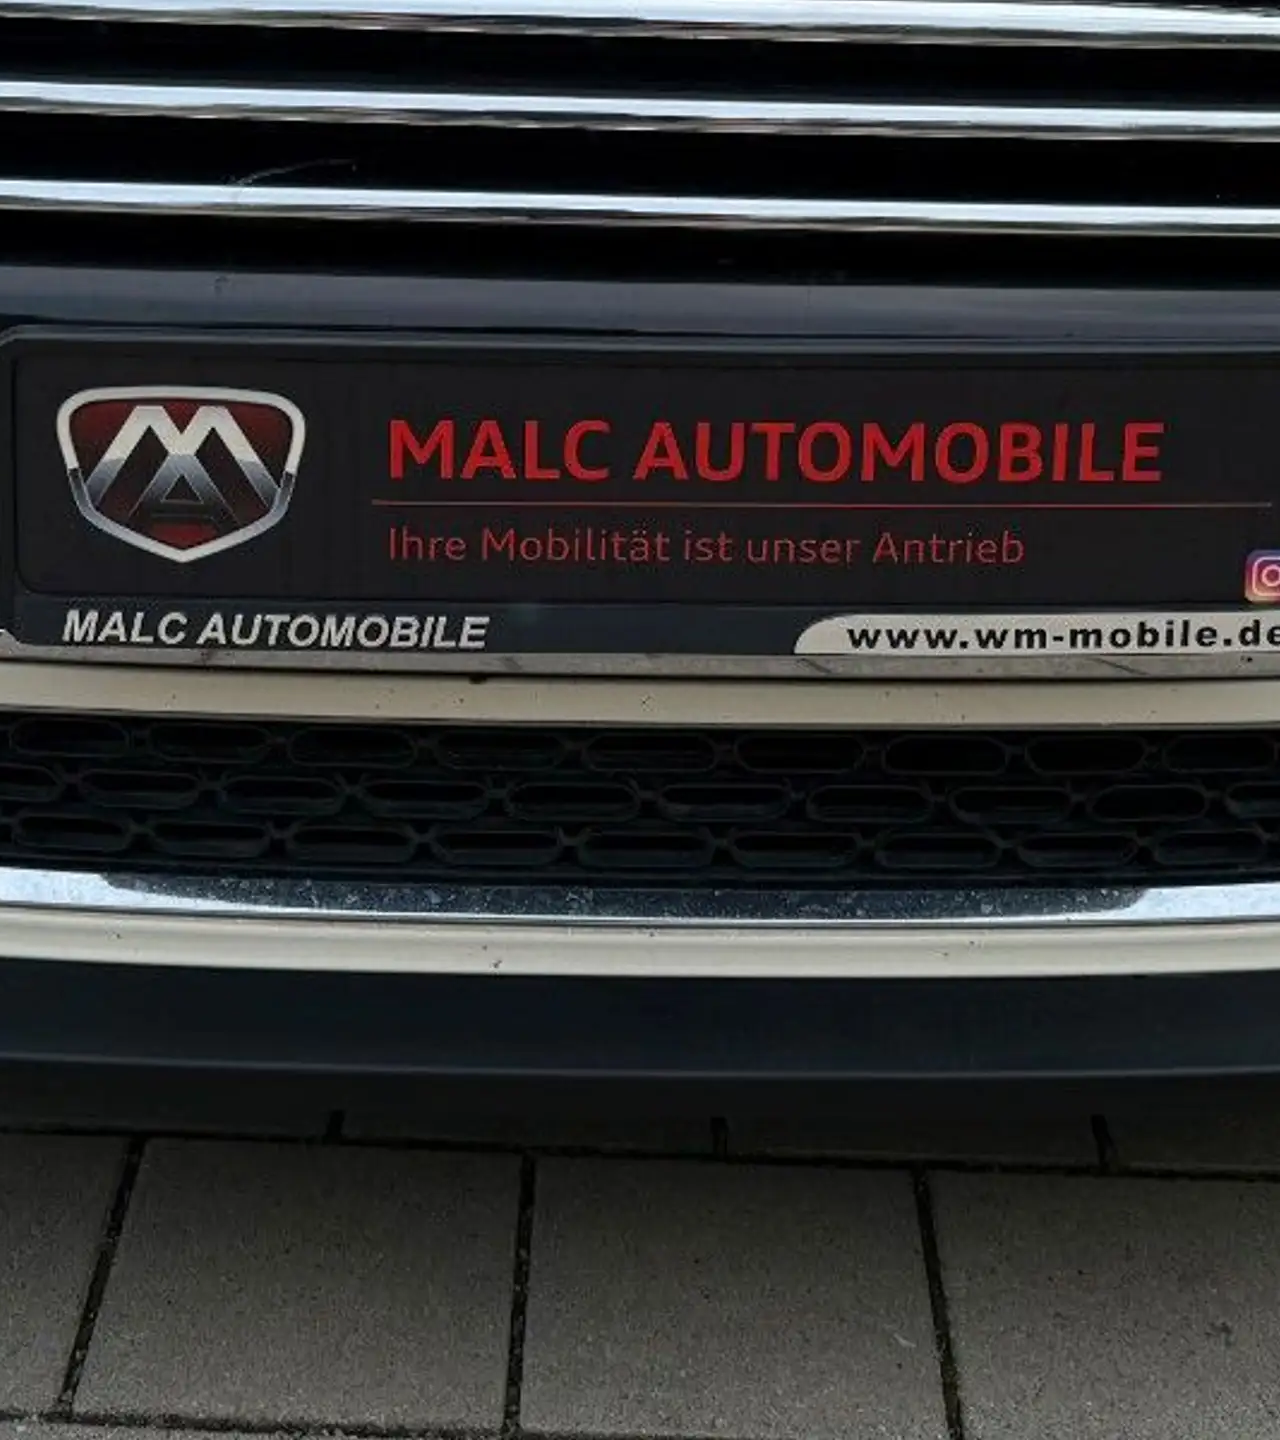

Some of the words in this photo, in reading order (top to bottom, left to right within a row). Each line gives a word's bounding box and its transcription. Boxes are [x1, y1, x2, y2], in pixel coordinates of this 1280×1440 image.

[389, 419, 611, 481] MALC
[632, 421, 1165, 484] AUTOMOBILE
[389, 526, 467, 561] Ihre
[480, 526, 671, 562] Mobilität
[683, 527, 733, 562] ist
[746, 537, 861, 564] unser
[872, 529, 1025, 564] Antrieb
[62, 608, 188, 646] MALC
[195, 612, 490, 651] AUTOMOBILE
